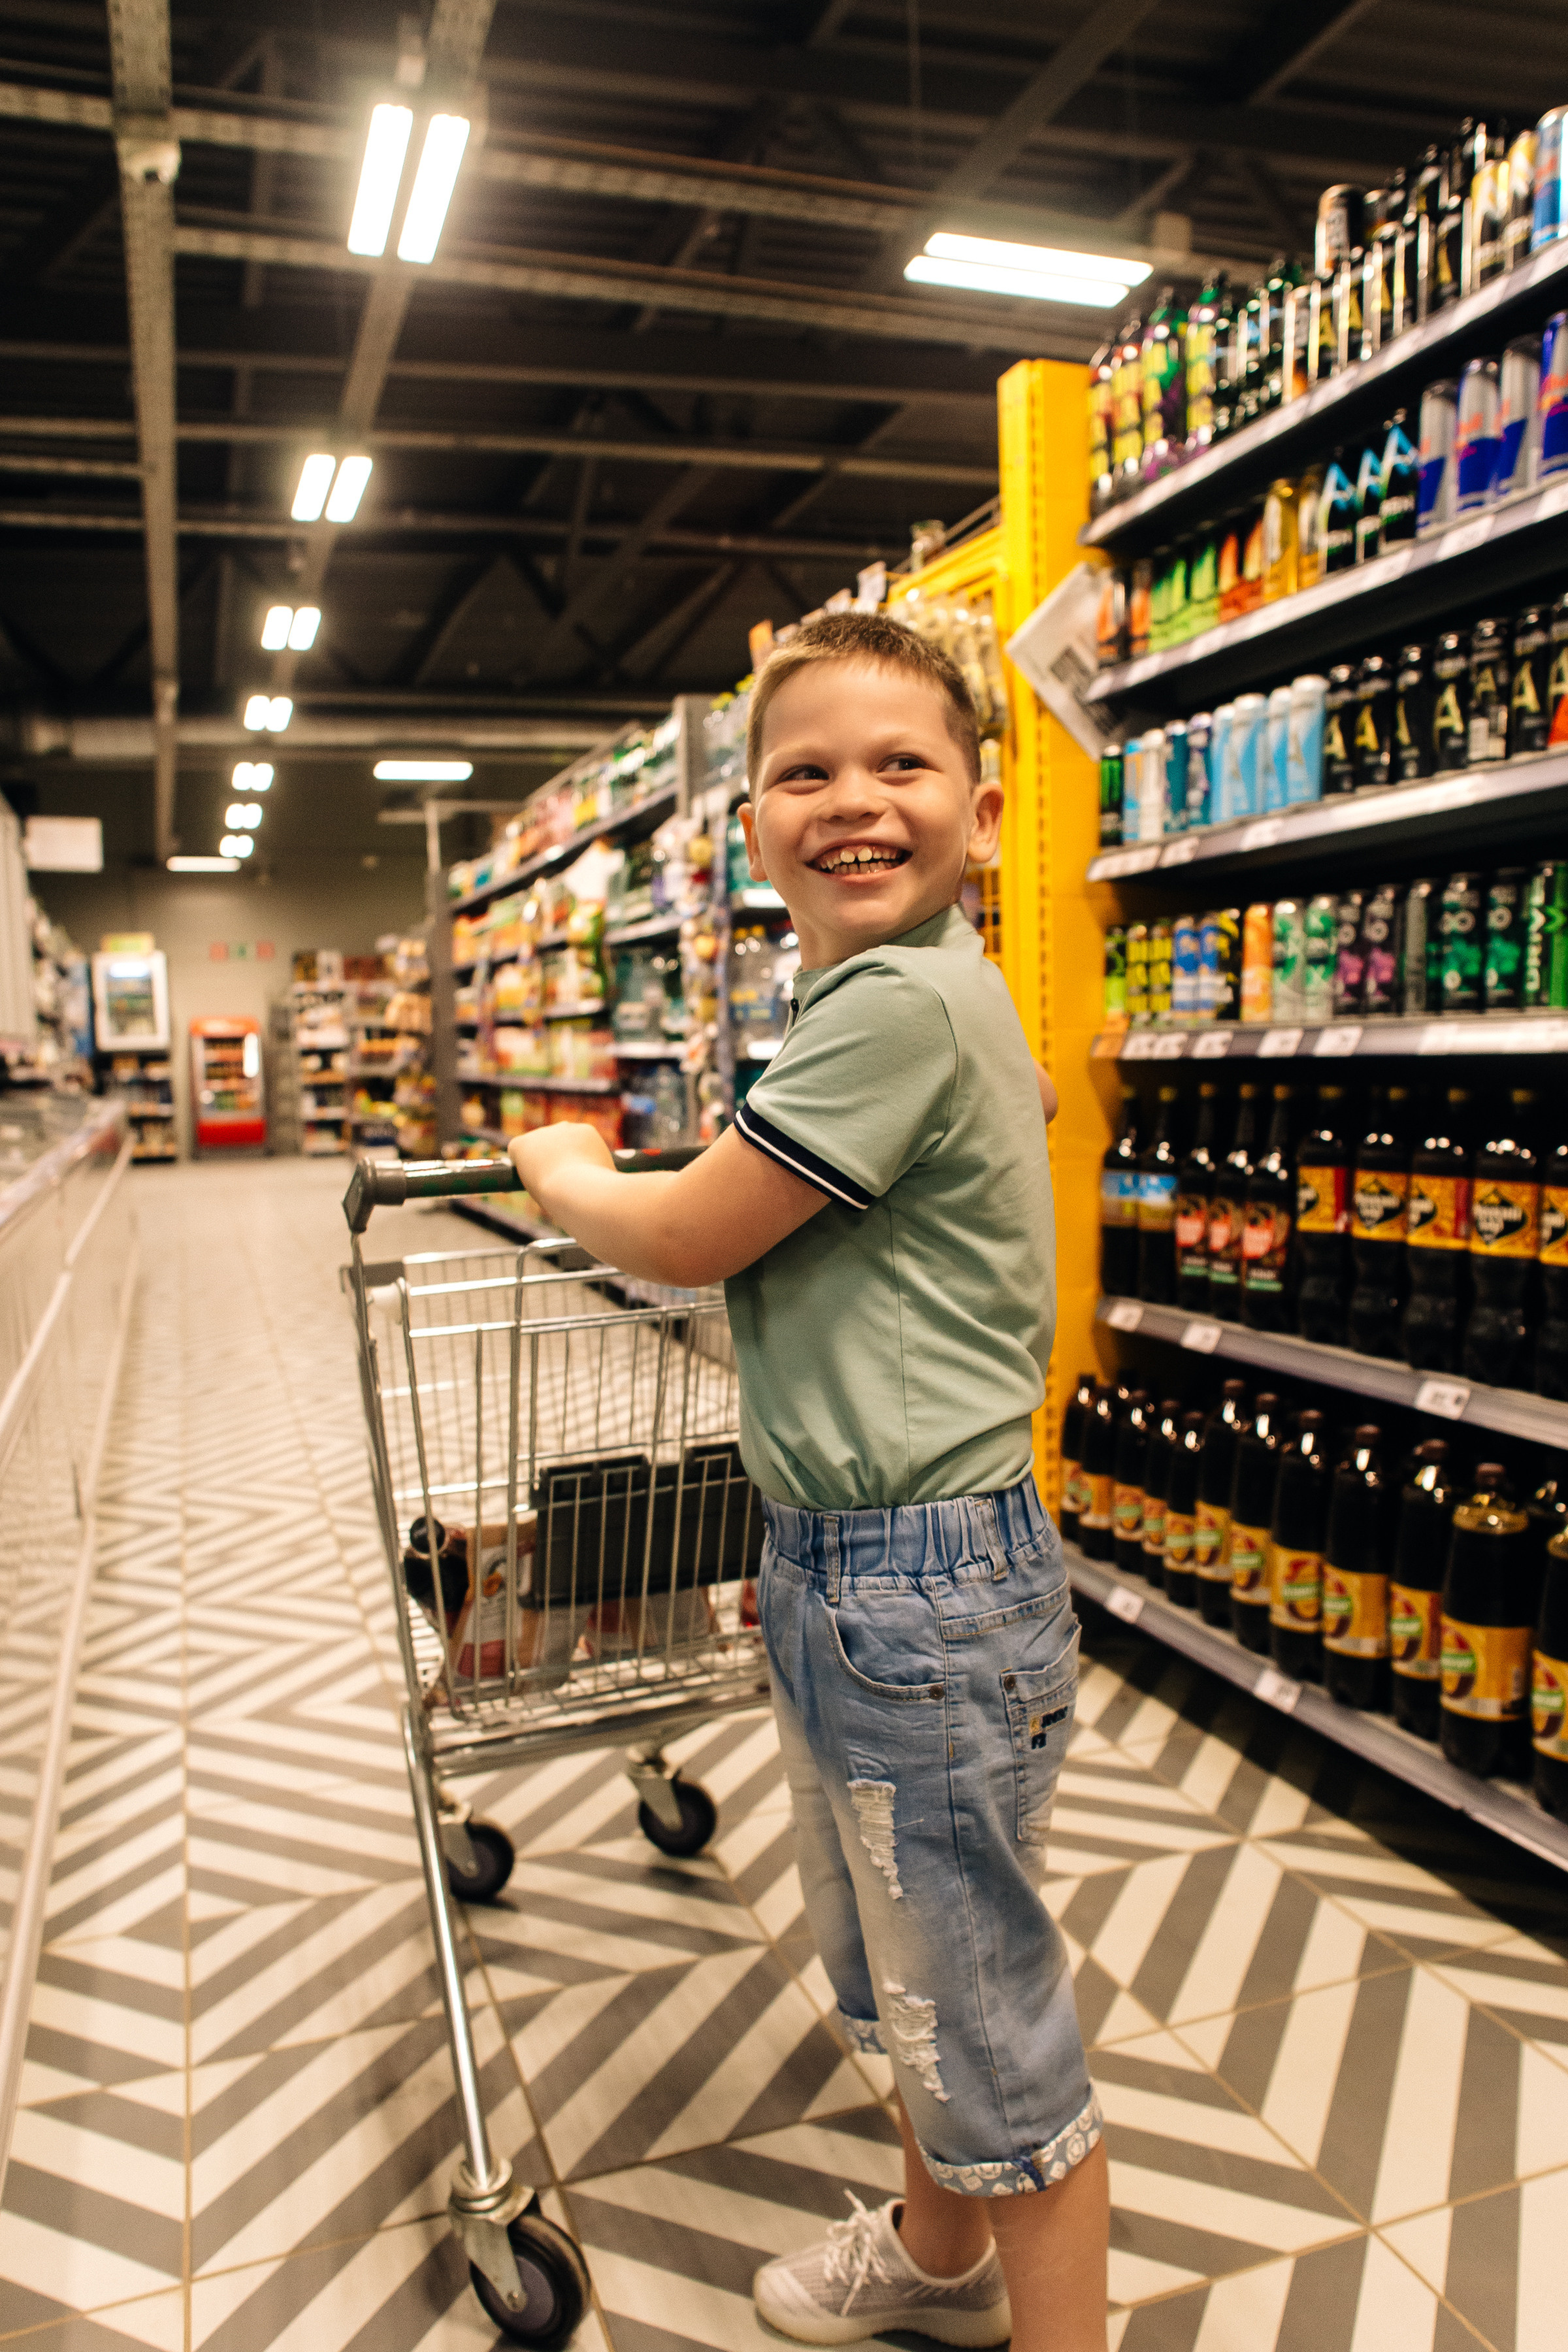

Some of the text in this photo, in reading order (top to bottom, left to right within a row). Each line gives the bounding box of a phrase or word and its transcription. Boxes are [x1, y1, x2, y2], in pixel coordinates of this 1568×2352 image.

[1433, 683, 1465, 749] A
[1511, 661, 1541, 724] A
[1323, 713, 1348, 761] A
[1355, 704, 1380, 751] A
